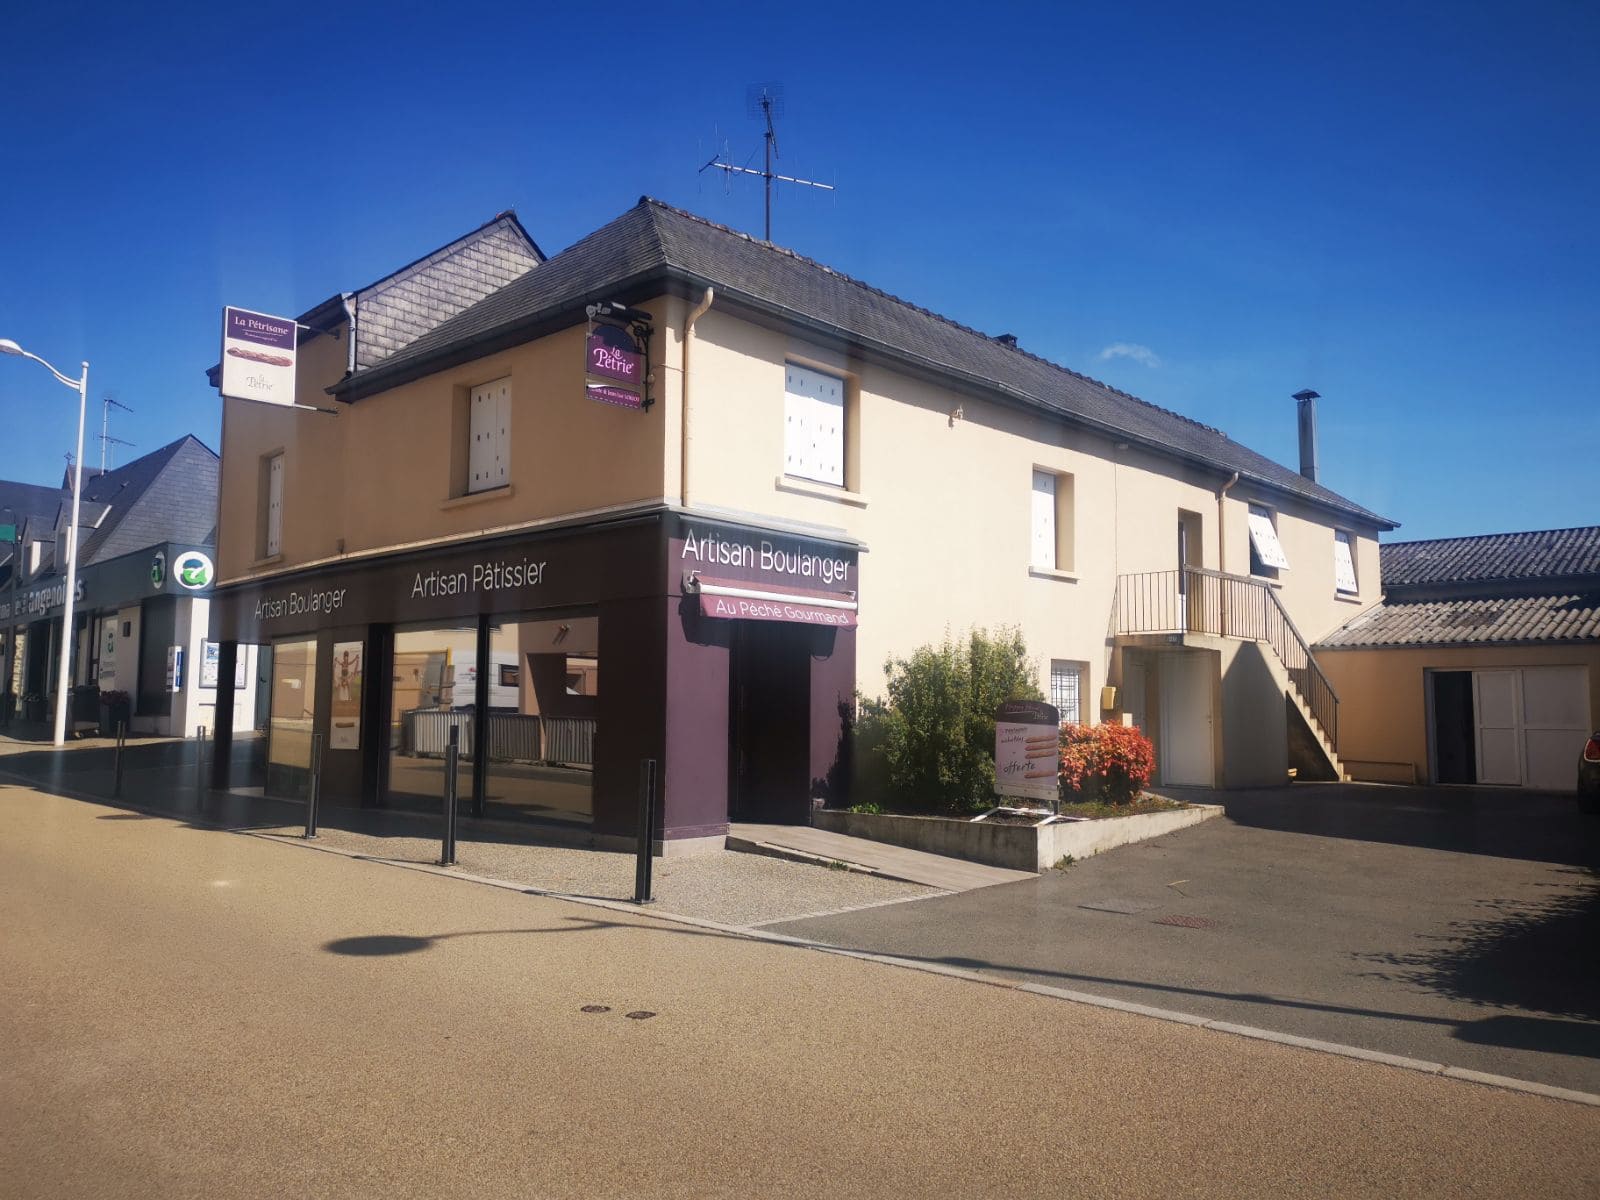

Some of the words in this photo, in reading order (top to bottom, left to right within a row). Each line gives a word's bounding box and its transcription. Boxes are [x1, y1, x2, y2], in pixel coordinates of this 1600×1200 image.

[234, 316, 246, 326] La
[248, 319, 289, 335] Pétrisane
[593, 348, 634, 374] Pétrie
[682, 528, 754, 568] Artisan
[760, 540, 850, 584] Boulanger
[411, 570, 467, 599] Artisan
[473, 557, 547, 592] Pâtissier
[254, 598, 288, 620] Artisan
[289, 587, 347, 615] Boulanger
[716, 599, 736, 615] Au
[739, 601, 782, 618] Péché
[784, 606, 849, 624] Gourmand
